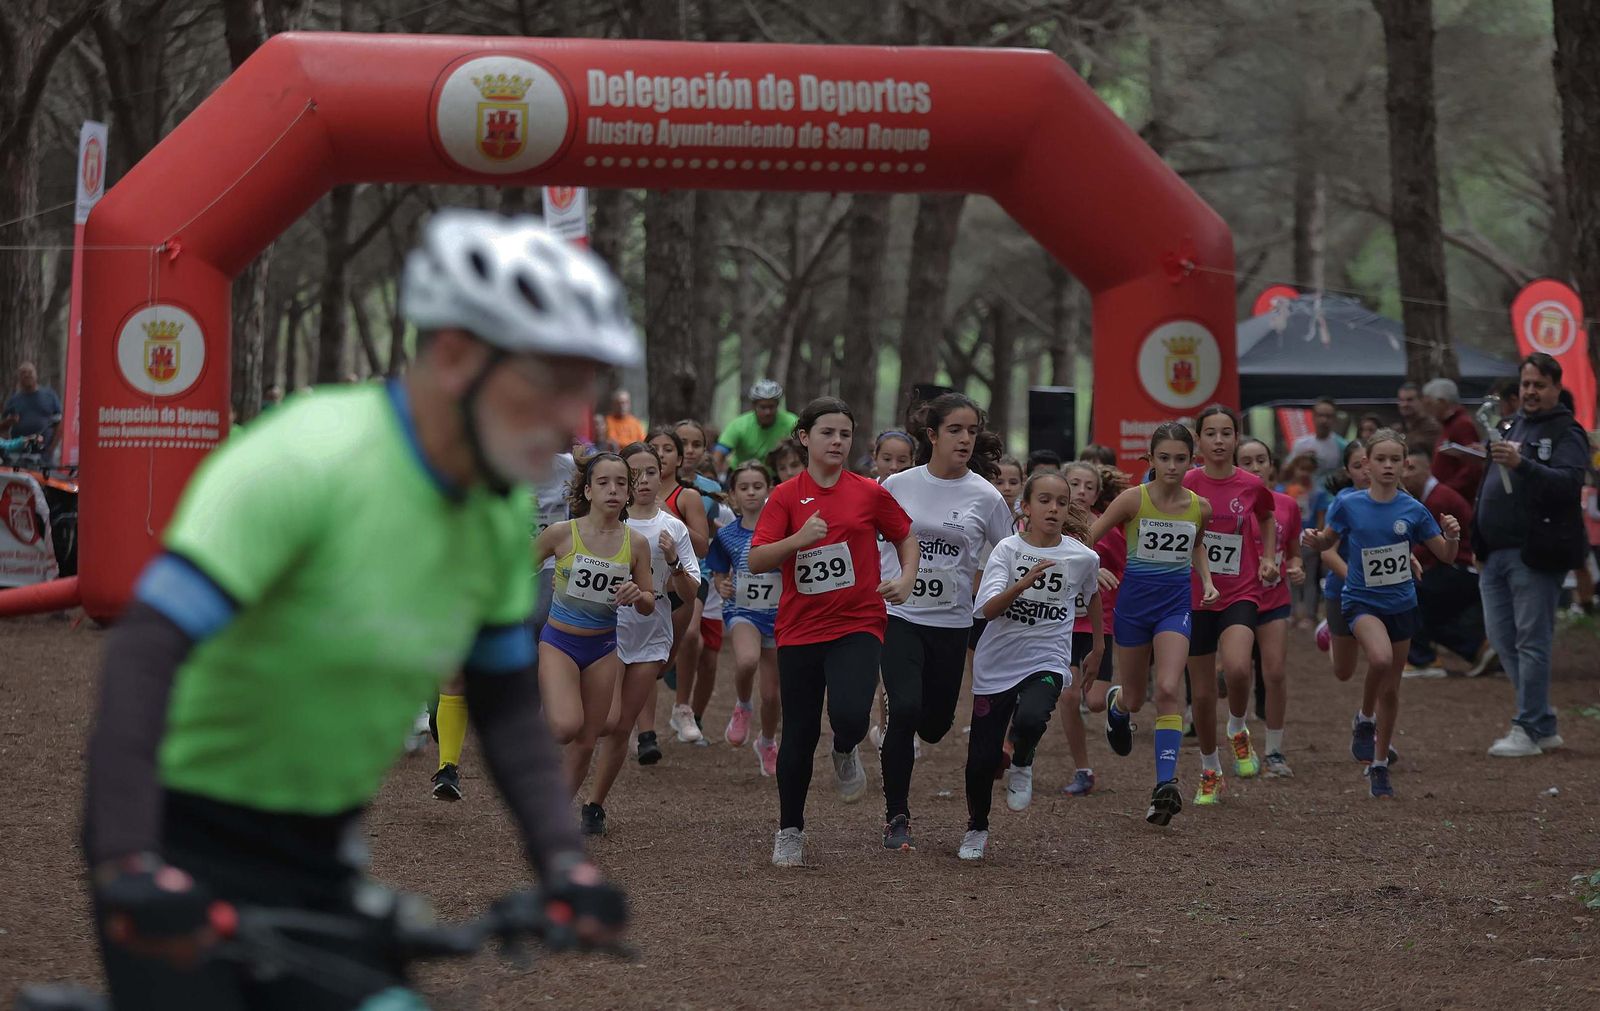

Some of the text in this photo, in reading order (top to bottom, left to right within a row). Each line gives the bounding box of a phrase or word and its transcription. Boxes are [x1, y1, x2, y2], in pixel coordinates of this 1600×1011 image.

[587, 69, 931, 116] Delegación de Deportes
[587, 117, 931, 152] Ilustre Ayuntamiento de San Roque
[919, 537, 960, 558] safíos
[1143, 531, 1190, 552] 322
[1369, 547, 1393, 555] CROSS
[583, 557, 610, 568] CROSS
[1202, 543, 1237, 564] 67
[797, 557, 846, 584] 239
[1368, 554, 1408, 577] 292
[574, 568, 625, 595] 305
[747, 584, 773, 600] 57
